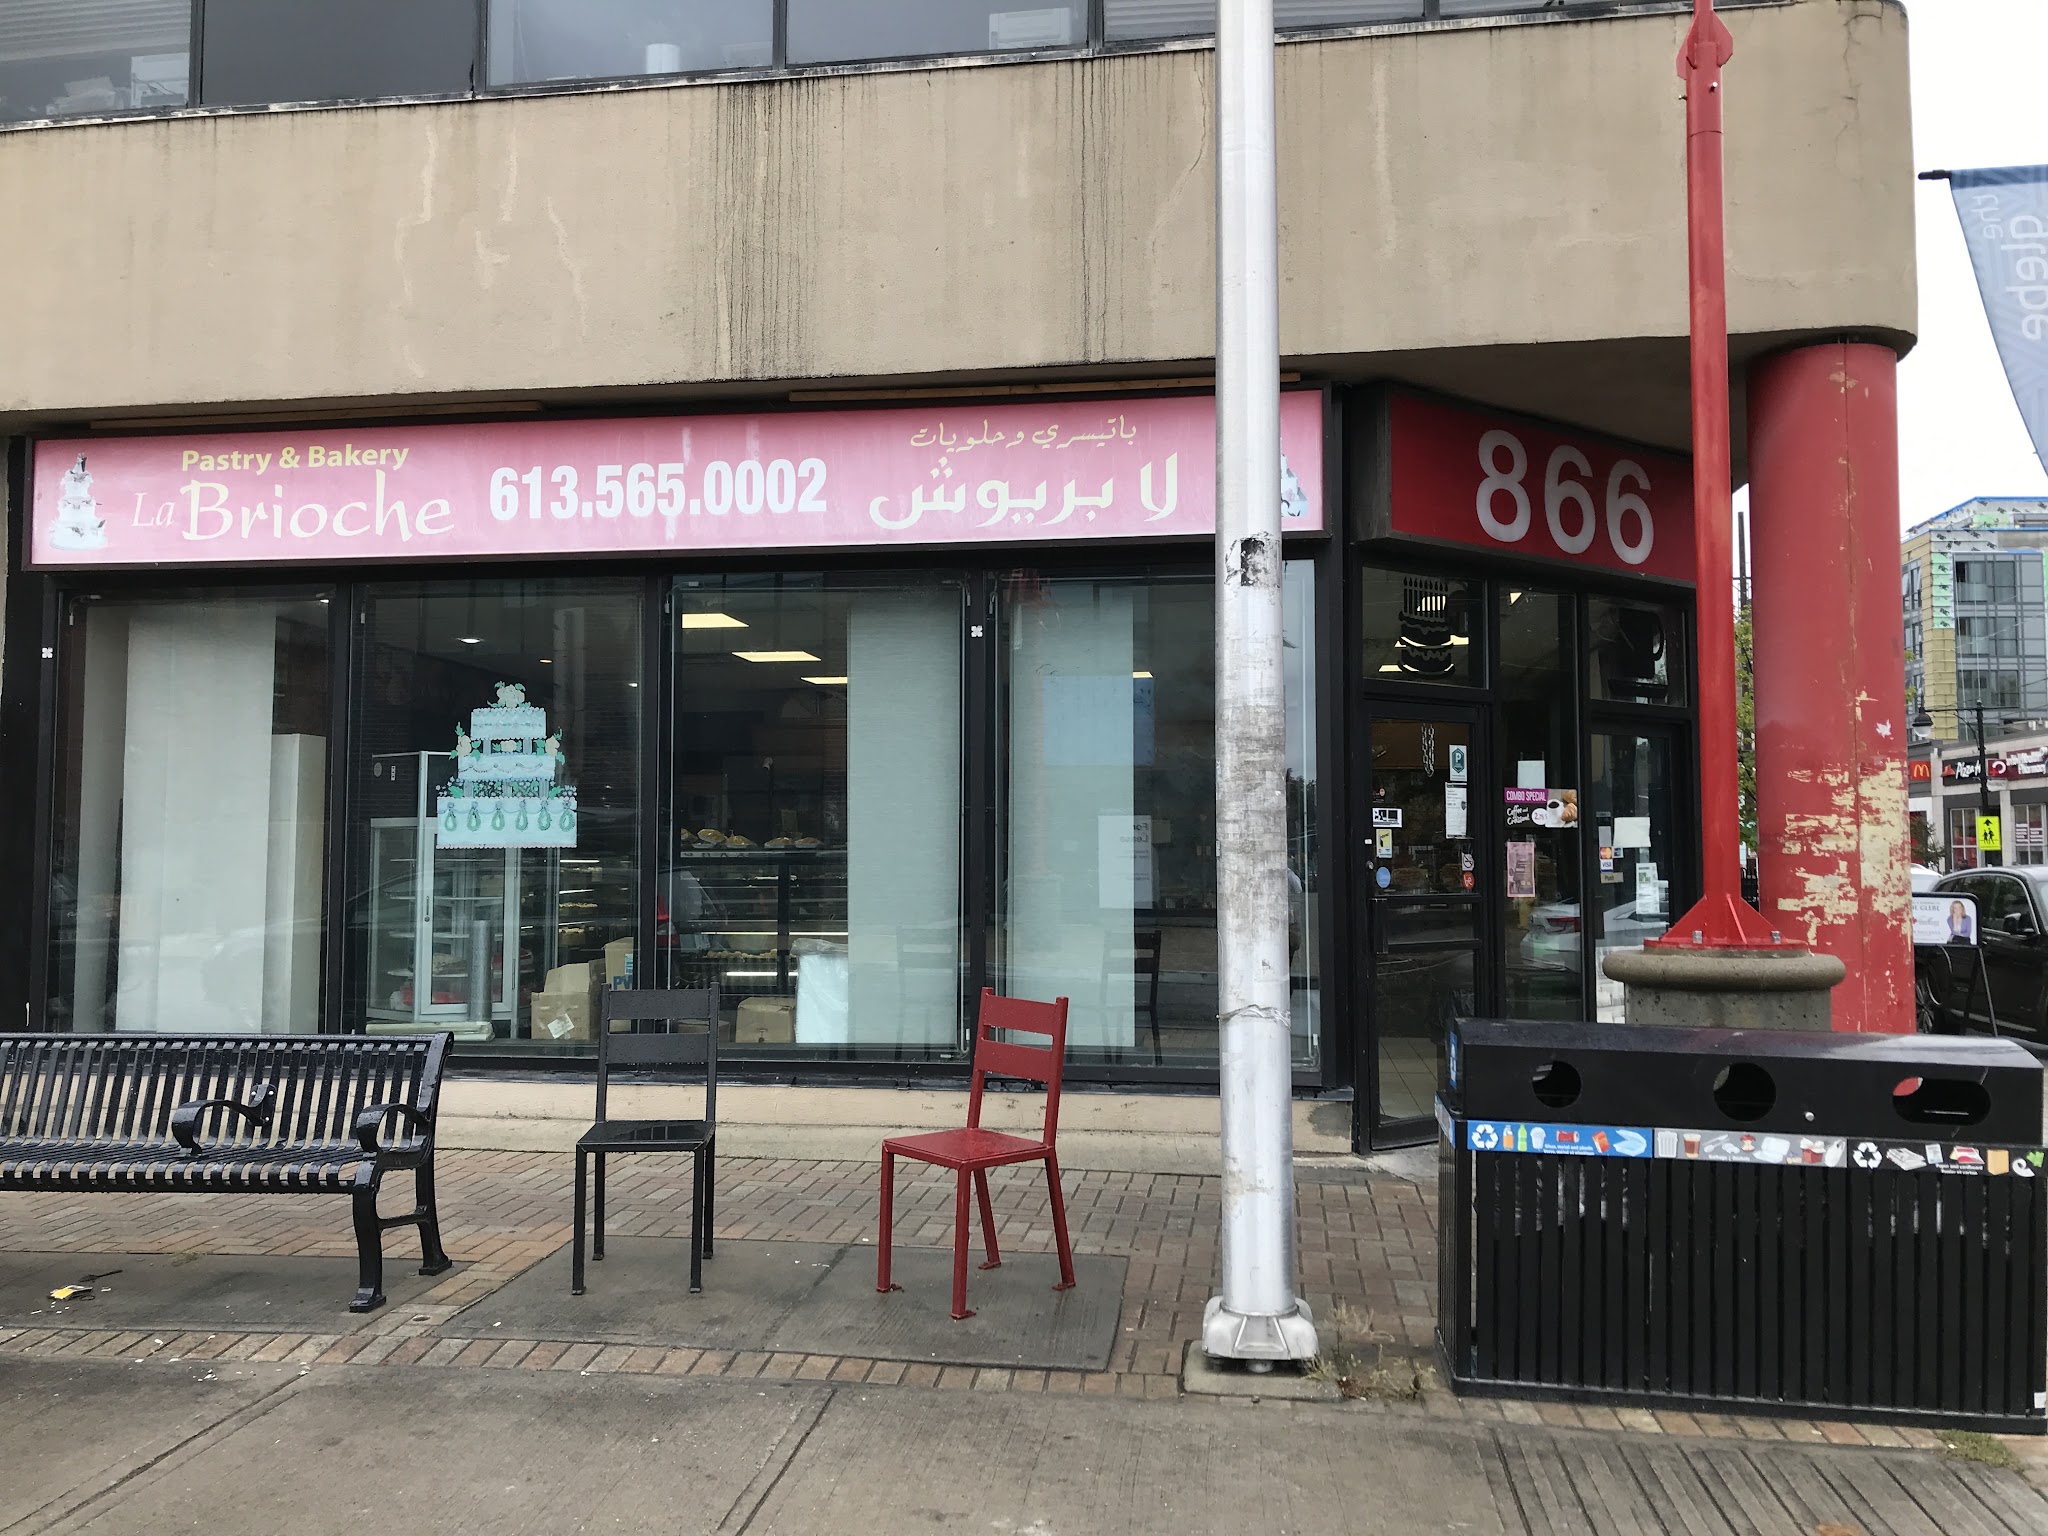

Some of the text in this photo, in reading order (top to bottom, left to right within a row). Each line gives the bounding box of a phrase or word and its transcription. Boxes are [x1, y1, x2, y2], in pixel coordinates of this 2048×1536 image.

[181, 443, 409, 476] Pastry & Bakery
[131, 468, 455, 542] La Brioche
[489, 457, 827, 521] 613.565.0002
[868, 451, 1178, 530] لا بريوش
[1475, 429, 1655, 565] 866
[1956, 761, 1974, 780] Pizza
[1506, 790, 1547, 802] COMBO SPECIAL
[1507, 804, 1523, 818] Coffee
